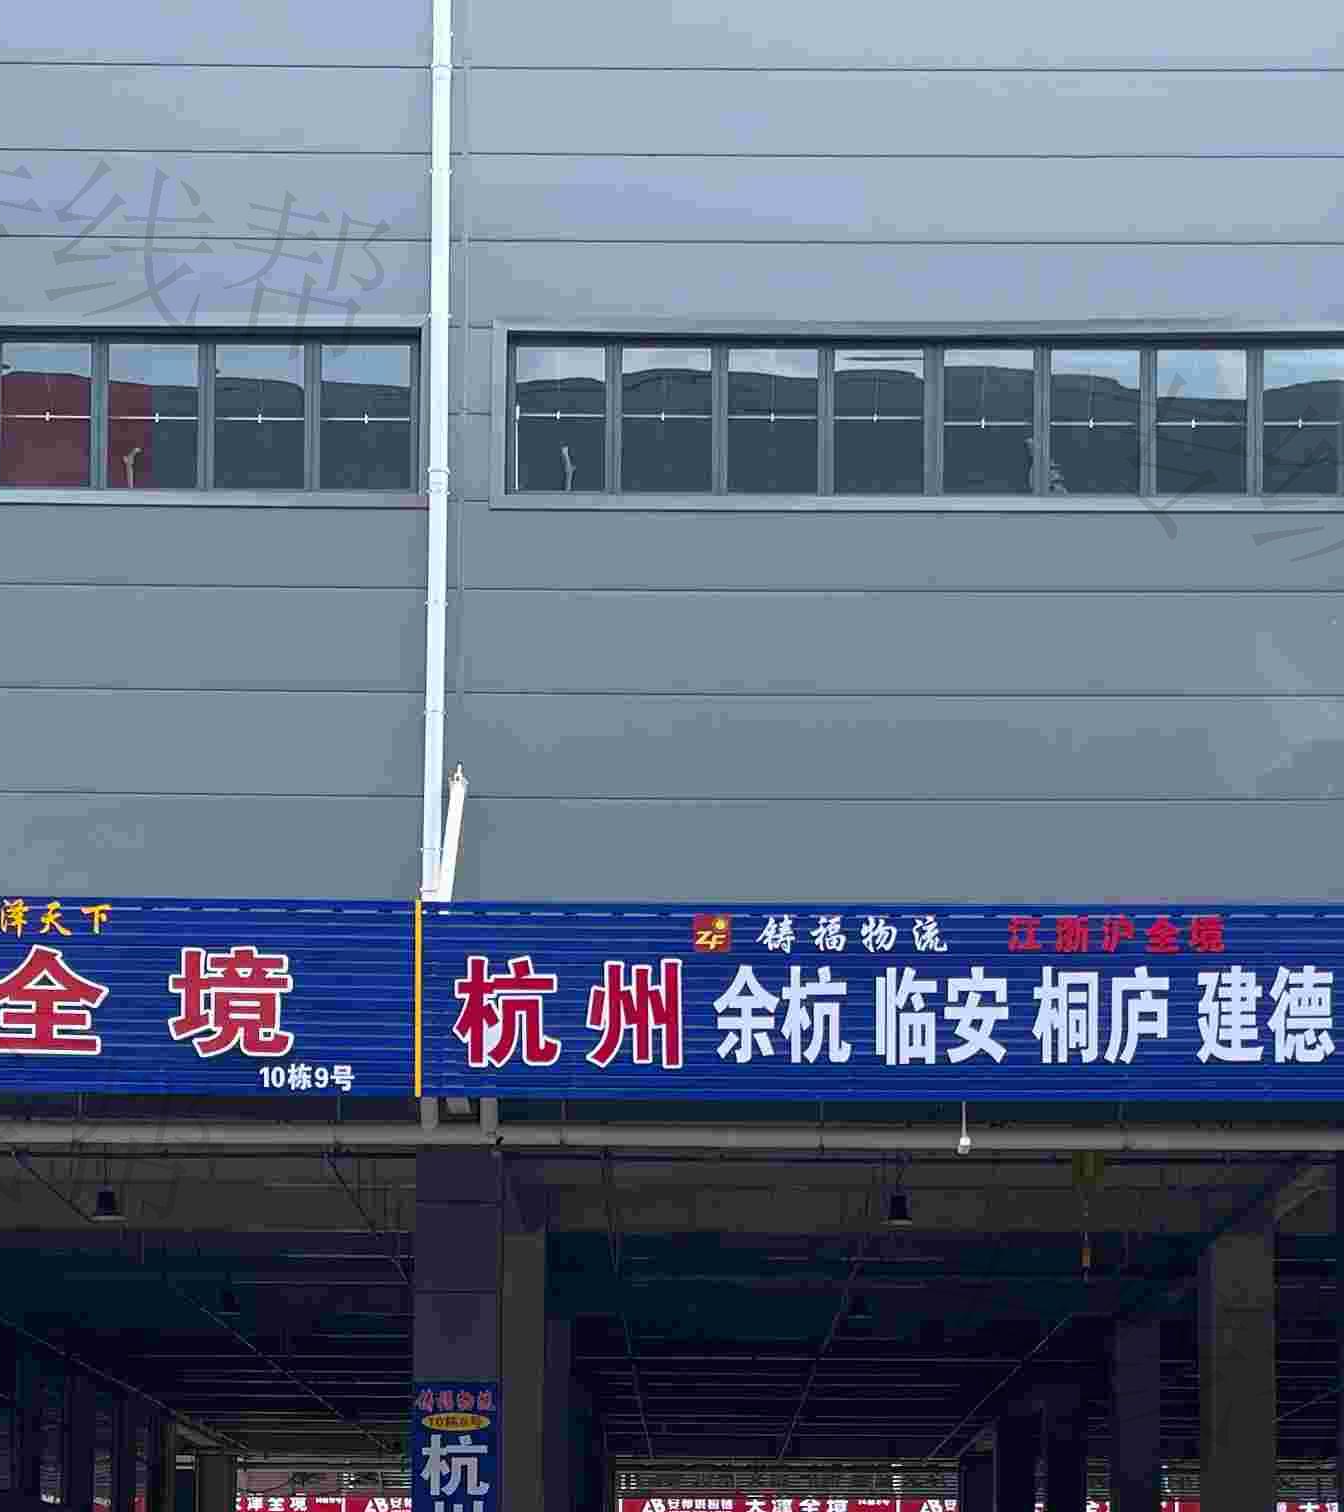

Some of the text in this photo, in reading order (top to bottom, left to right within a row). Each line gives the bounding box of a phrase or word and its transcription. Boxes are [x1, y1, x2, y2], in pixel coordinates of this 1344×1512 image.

[1007, 914, 1225, 953] 江浙沪全境
[453, 956, 684, 1069] 杭州
[713, 964, 853, 1065] 余杭
[875, 966, 1009, 1066] 临安
[1032, 966, 1170, 1064] 桐庐
[1196, 965, 1335, 1064] 建德
[259, 1065, 355, 1092] 10栋9号
